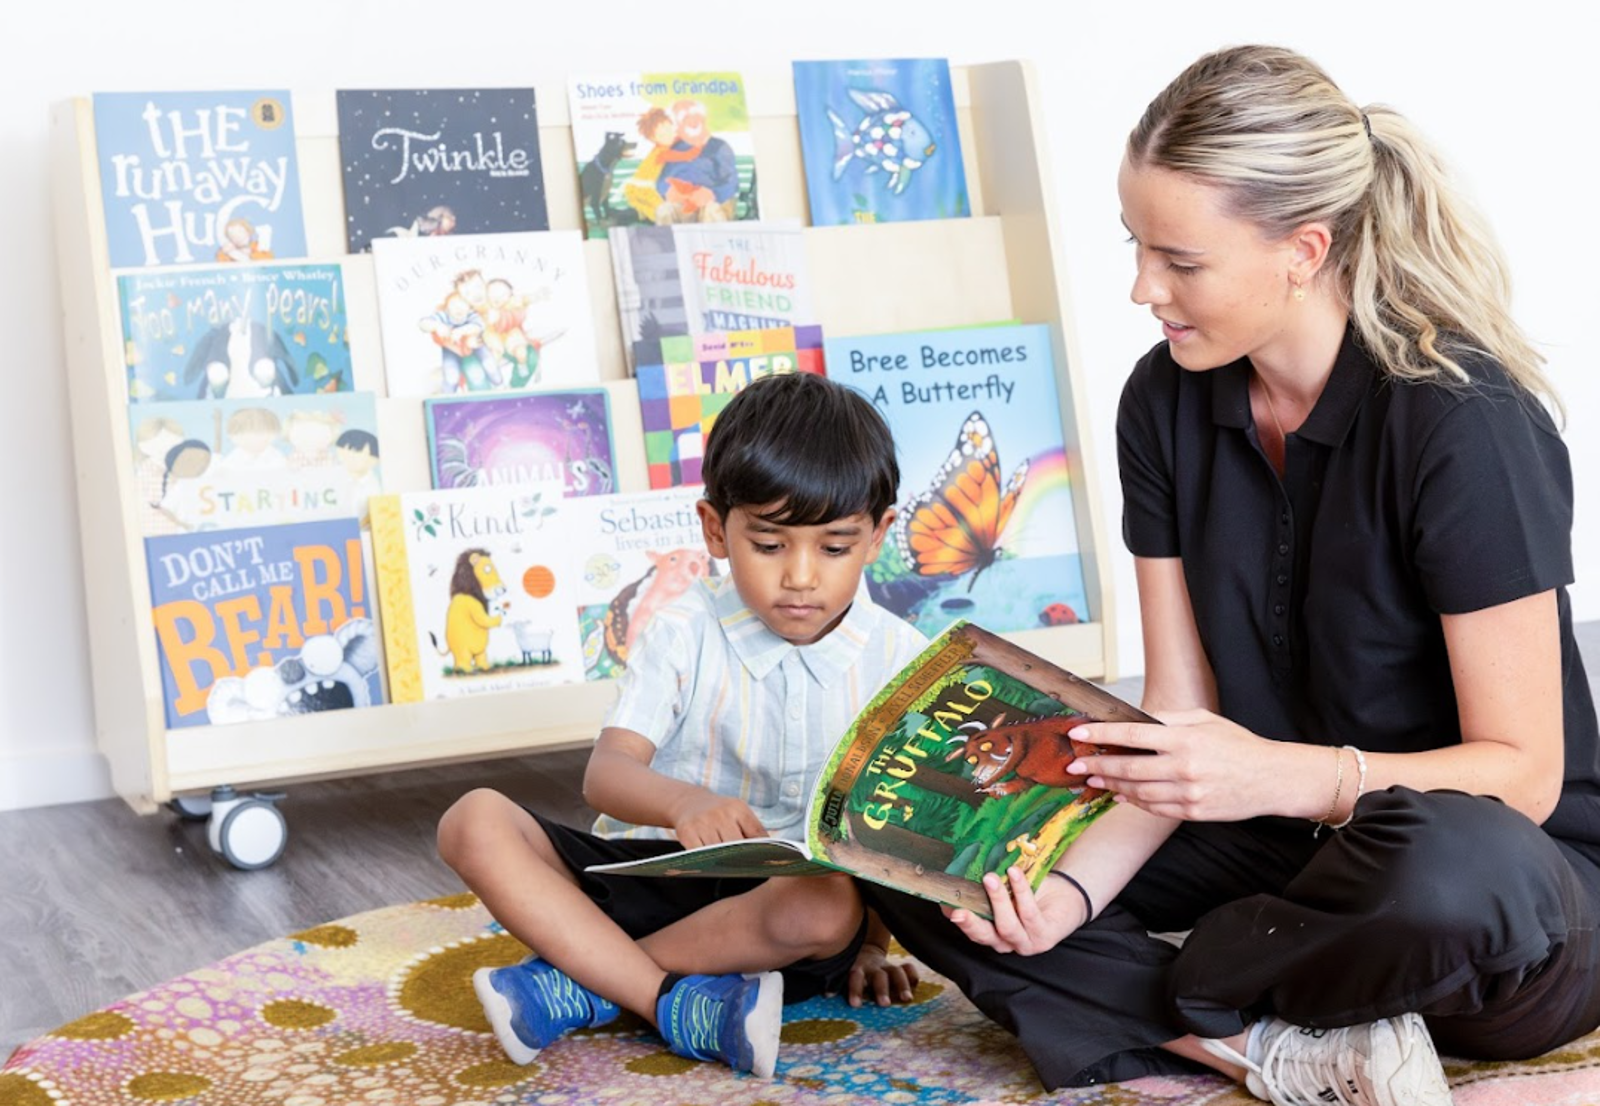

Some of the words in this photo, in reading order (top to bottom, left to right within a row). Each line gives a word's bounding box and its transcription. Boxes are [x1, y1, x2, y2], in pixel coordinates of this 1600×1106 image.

[576, 83, 624, 99] Shoes
[629, 80, 668, 96] from
[672, 78, 739, 97] Grandpa
[371, 127, 532, 185] Twinkle
[454, 244, 567, 283] GRANNY
[692, 251, 796, 290] Fabulous
[705, 286, 793, 313] FRIEND
[850, 349, 908, 373] Bree
[920, 345, 1028, 369] Becomes
[872, 385, 889, 405] A
[901, 374, 1016, 405] Butterfly
[199, 484, 338, 516] STARTING
[449, 501, 523, 540] Kind
[192, 569, 256, 602] CALL
[257, 561, 294, 585] ME
[152, 539, 366, 717] BEAR!
[863, 679, 993, 830] GRUFFALO
[866, 744, 898, 777] THE
